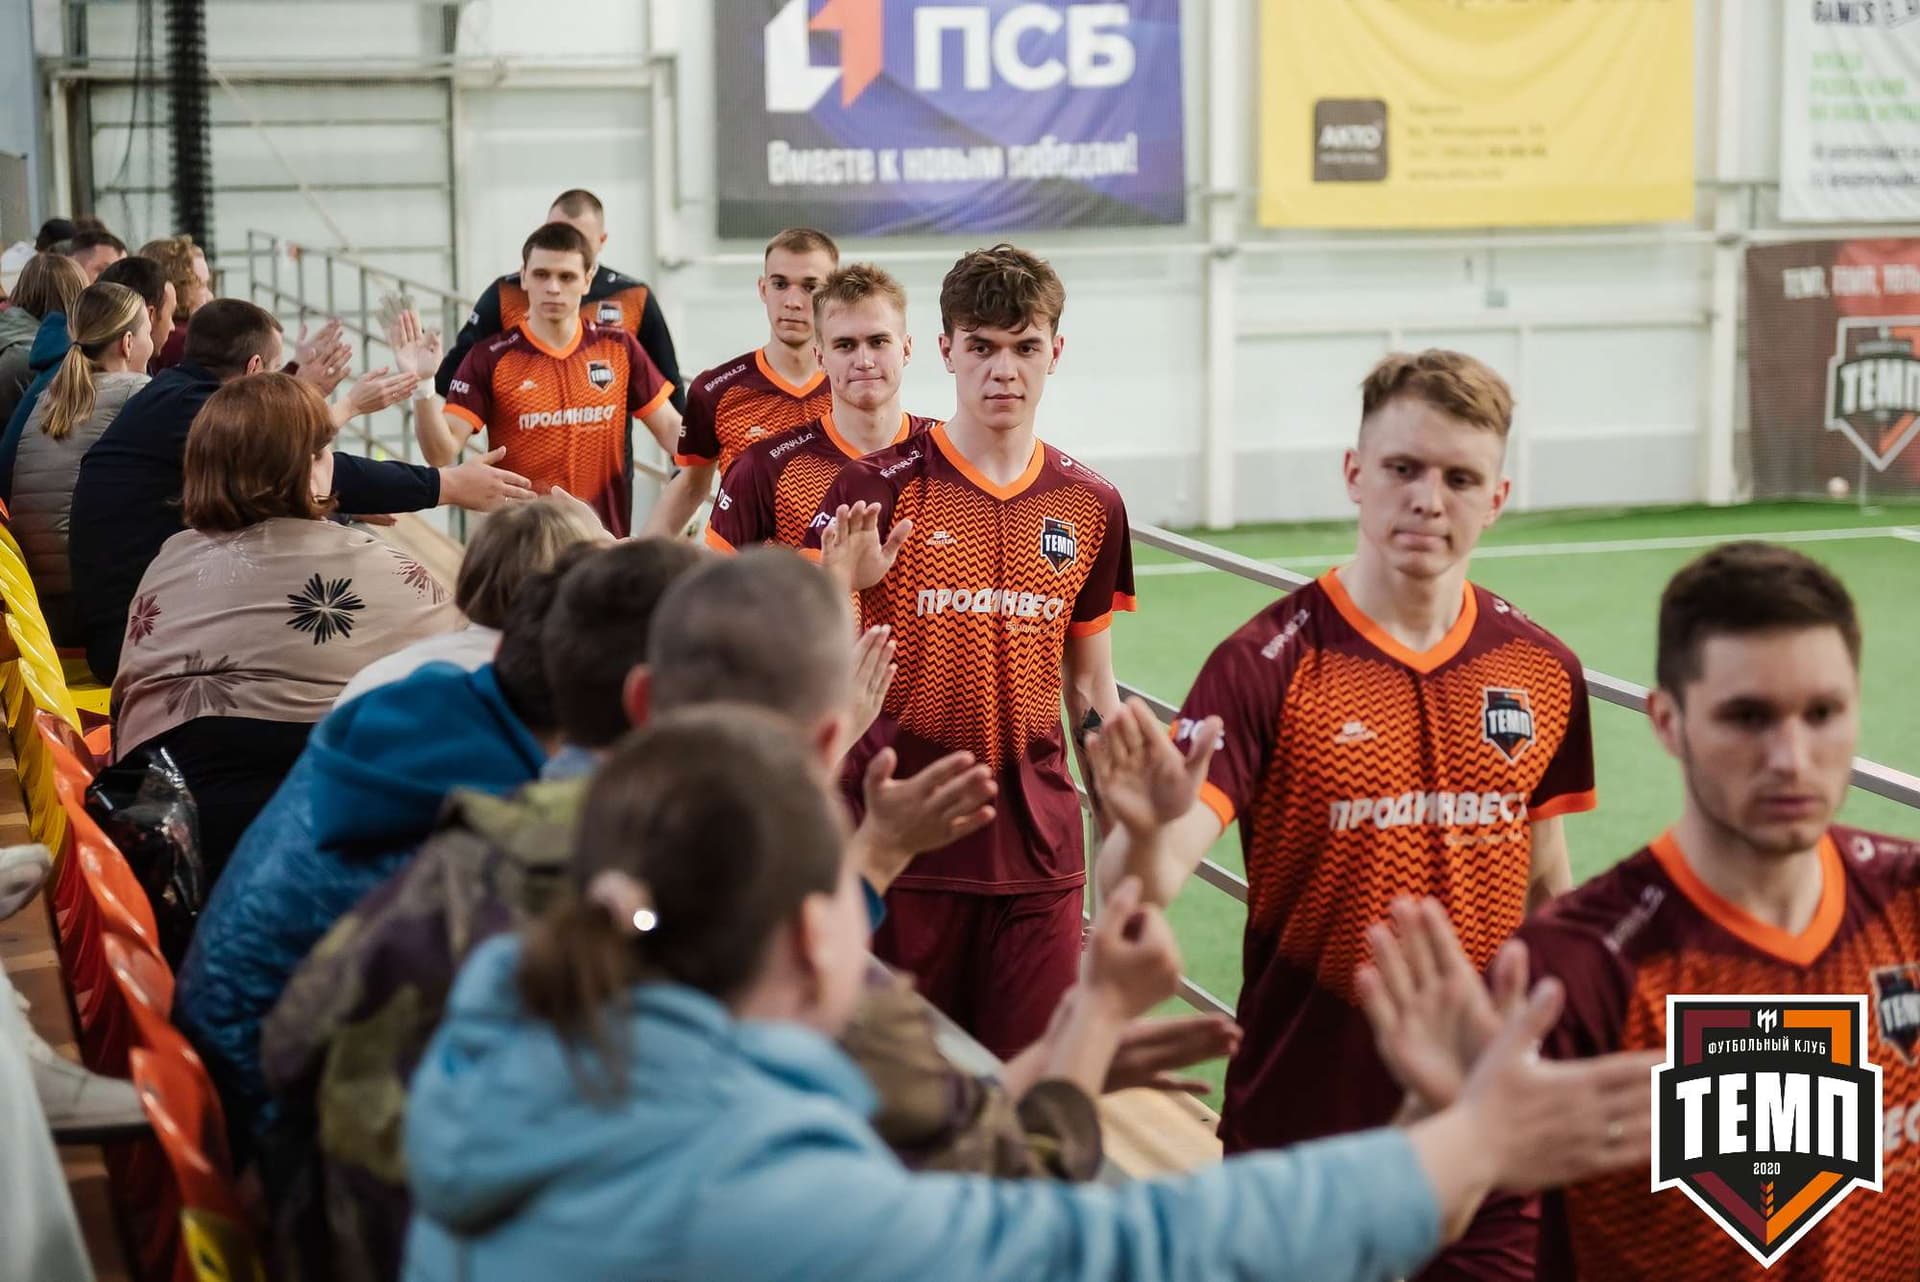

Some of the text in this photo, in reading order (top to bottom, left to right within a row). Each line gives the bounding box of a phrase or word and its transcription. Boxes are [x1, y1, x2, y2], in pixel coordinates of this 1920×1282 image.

[913, 3, 1137, 91] ПСБ
[767, 140, 875, 184] Вместе
[879, 149, 898, 183] к
[1044, 534, 1073, 558] ТЕМП
[1487, 709, 1531, 738] ТЕМП
